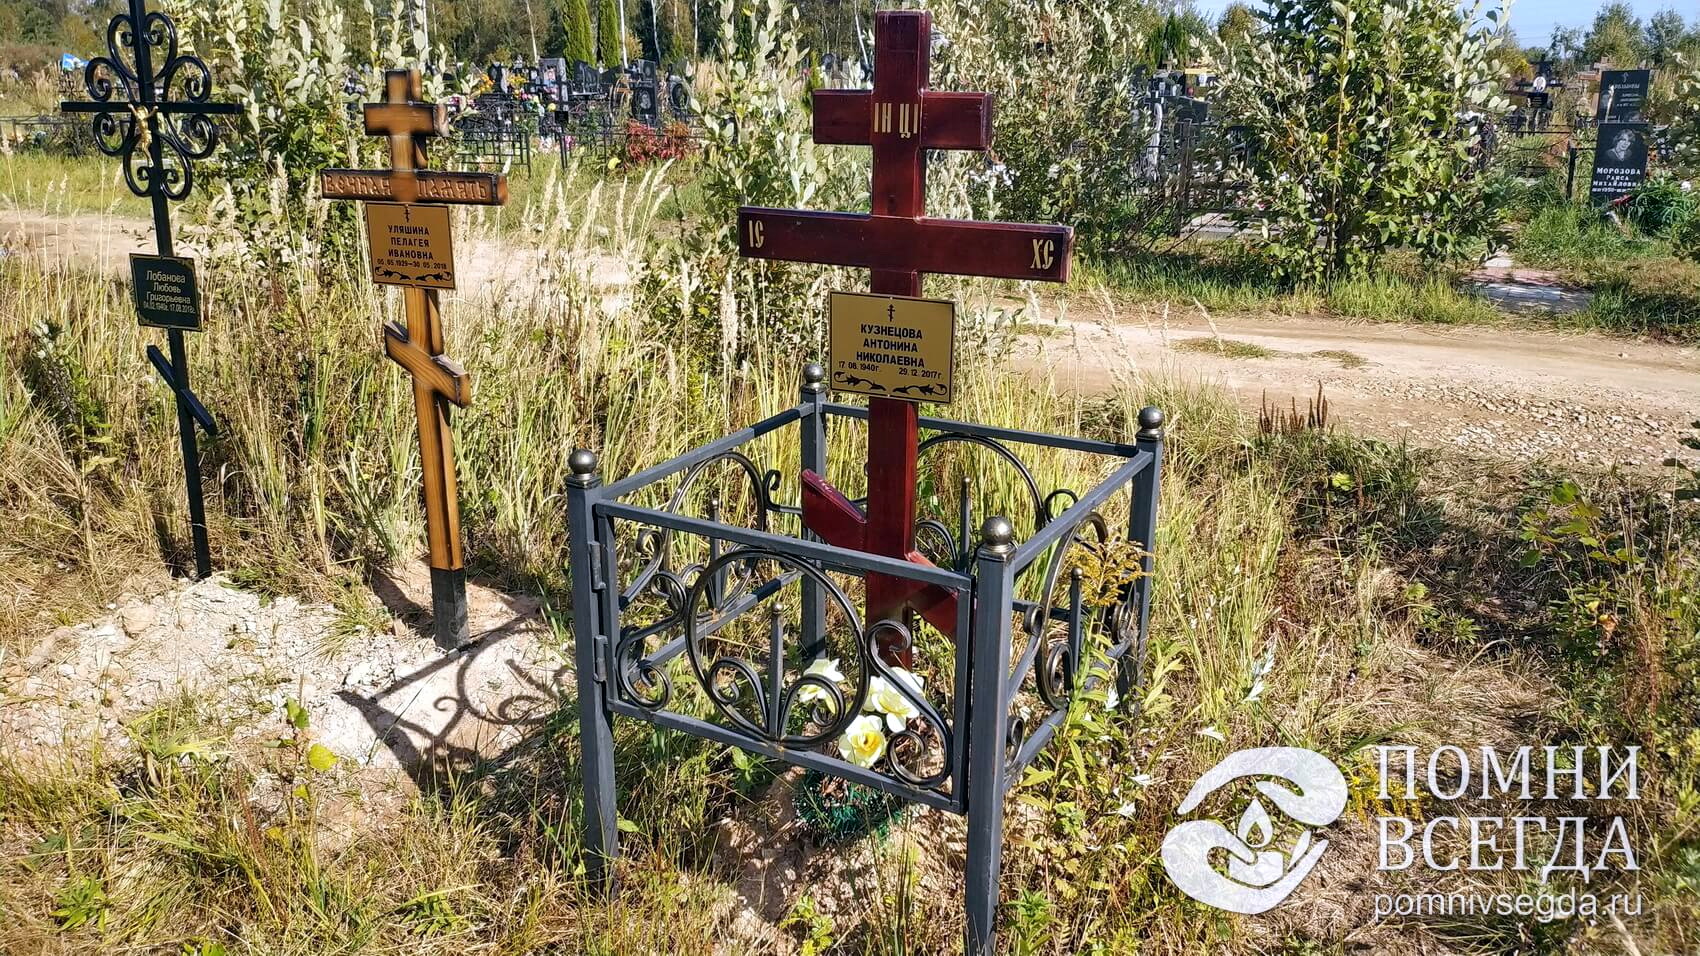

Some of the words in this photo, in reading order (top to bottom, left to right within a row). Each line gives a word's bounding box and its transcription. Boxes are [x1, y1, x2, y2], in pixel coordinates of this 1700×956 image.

[1596, 167, 1641, 175] МОРОЗОВА
[388, 224, 430, 236] УЛЯШИНА
[390, 236, 430, 248] ПЕЛАГЕЯ
[388, 248, 434, 260] ИВАНОВНА
[146, 270, 186, 284] Лобанова
[153, 281, 182, 294] Любовь
[146, 291, 191, 305] Григорьевна
[860, 323, 923, 340] КУЗНЕЦОВА
[863, 338, 918, 353] АНТОНИНА
[856, 351, 925, 368] НИКОЛАЕВНА
